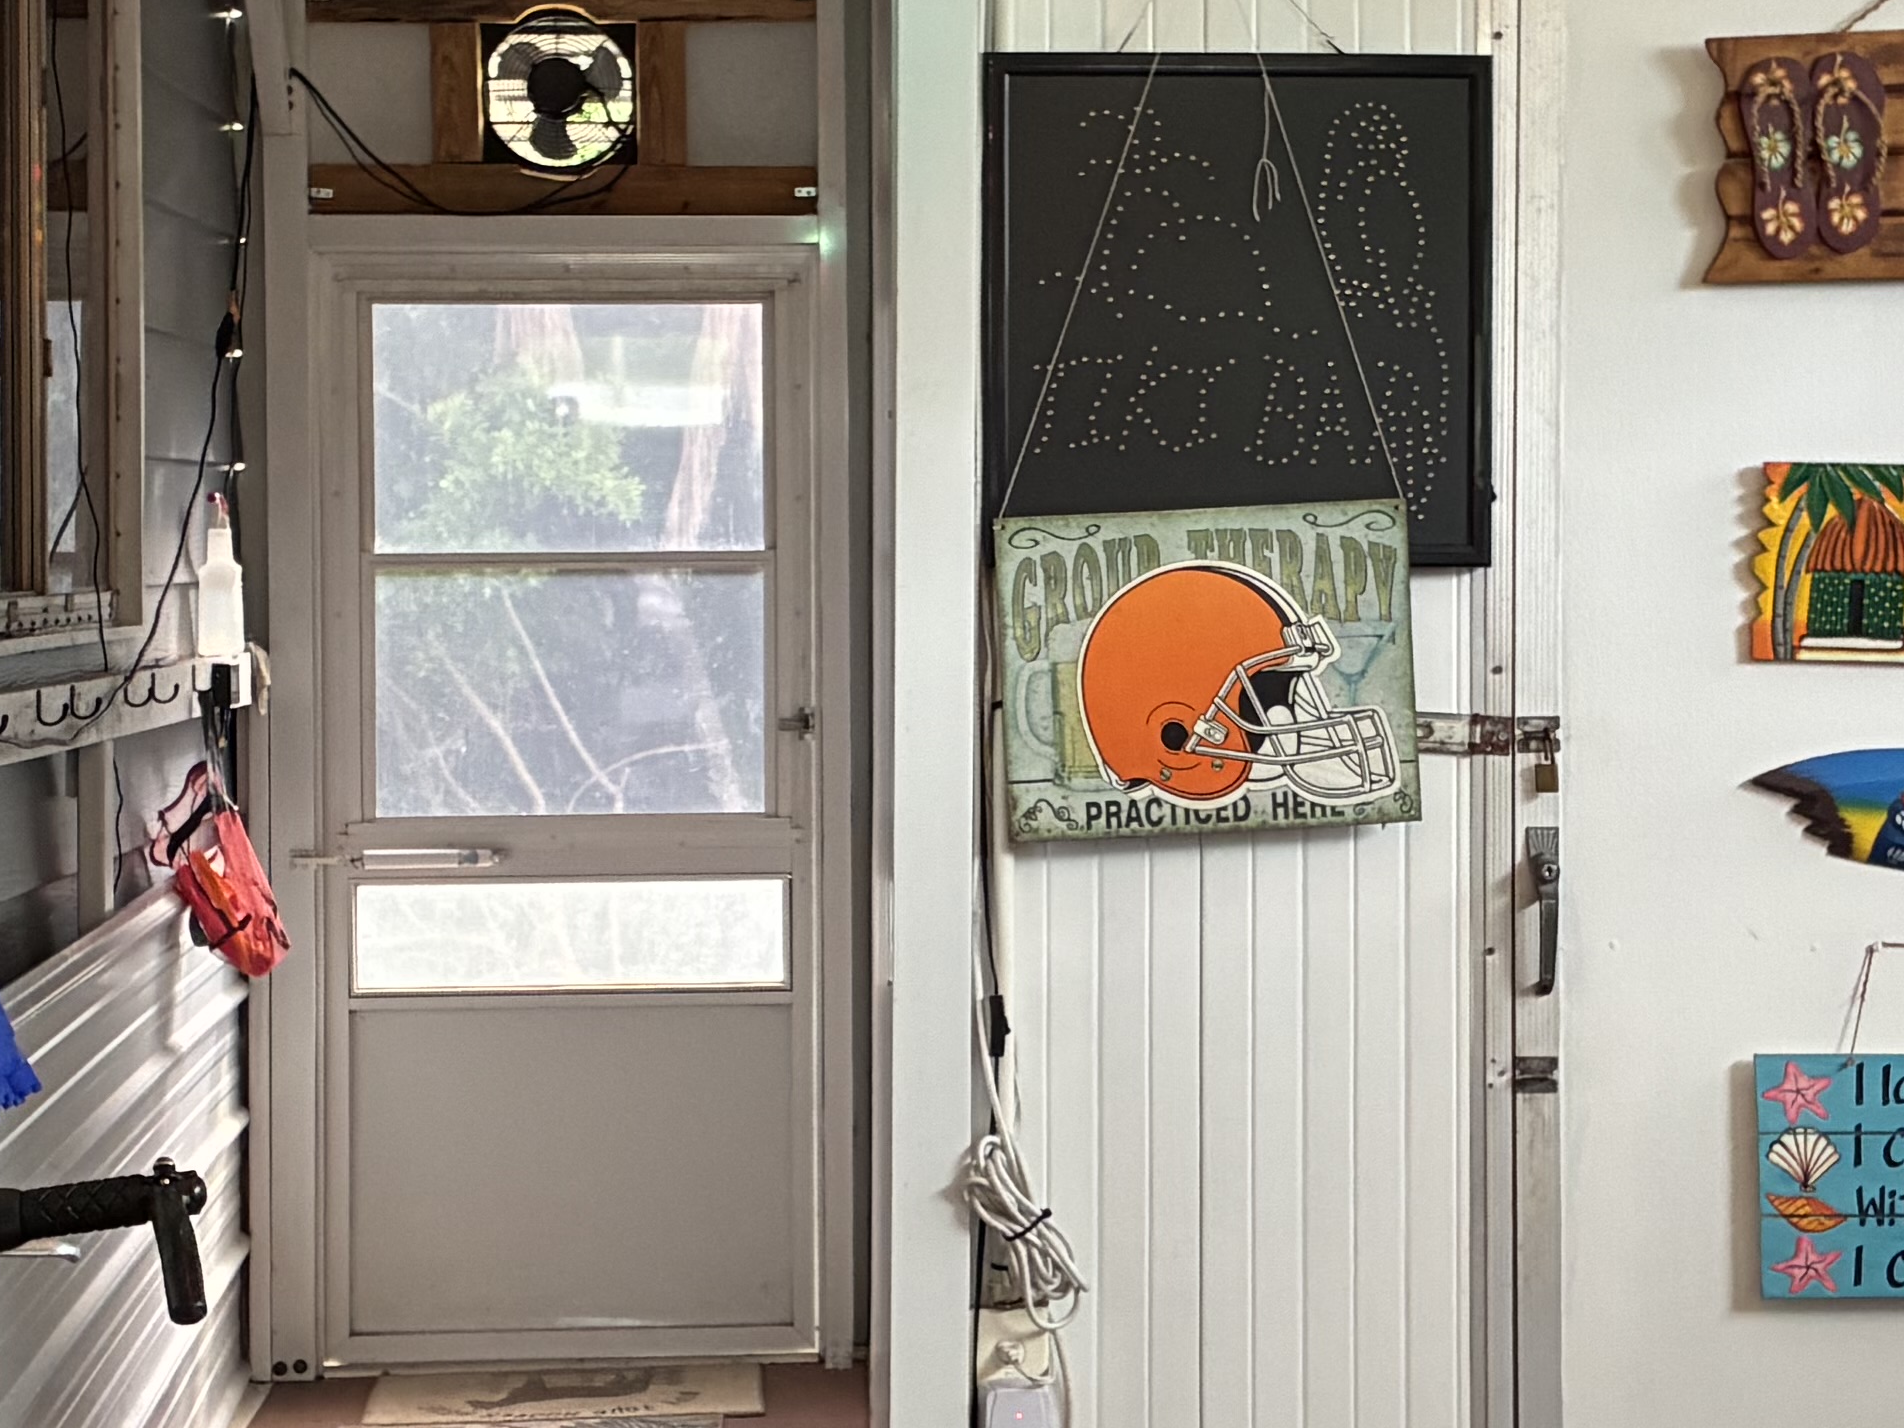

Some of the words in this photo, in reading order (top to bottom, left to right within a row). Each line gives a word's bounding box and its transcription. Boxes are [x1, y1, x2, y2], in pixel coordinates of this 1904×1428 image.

[1853, 1061, 1865, 1107] I
[1853, 1123, 1863, 1168] I
[1853, 1244, 1864, 1287] I
